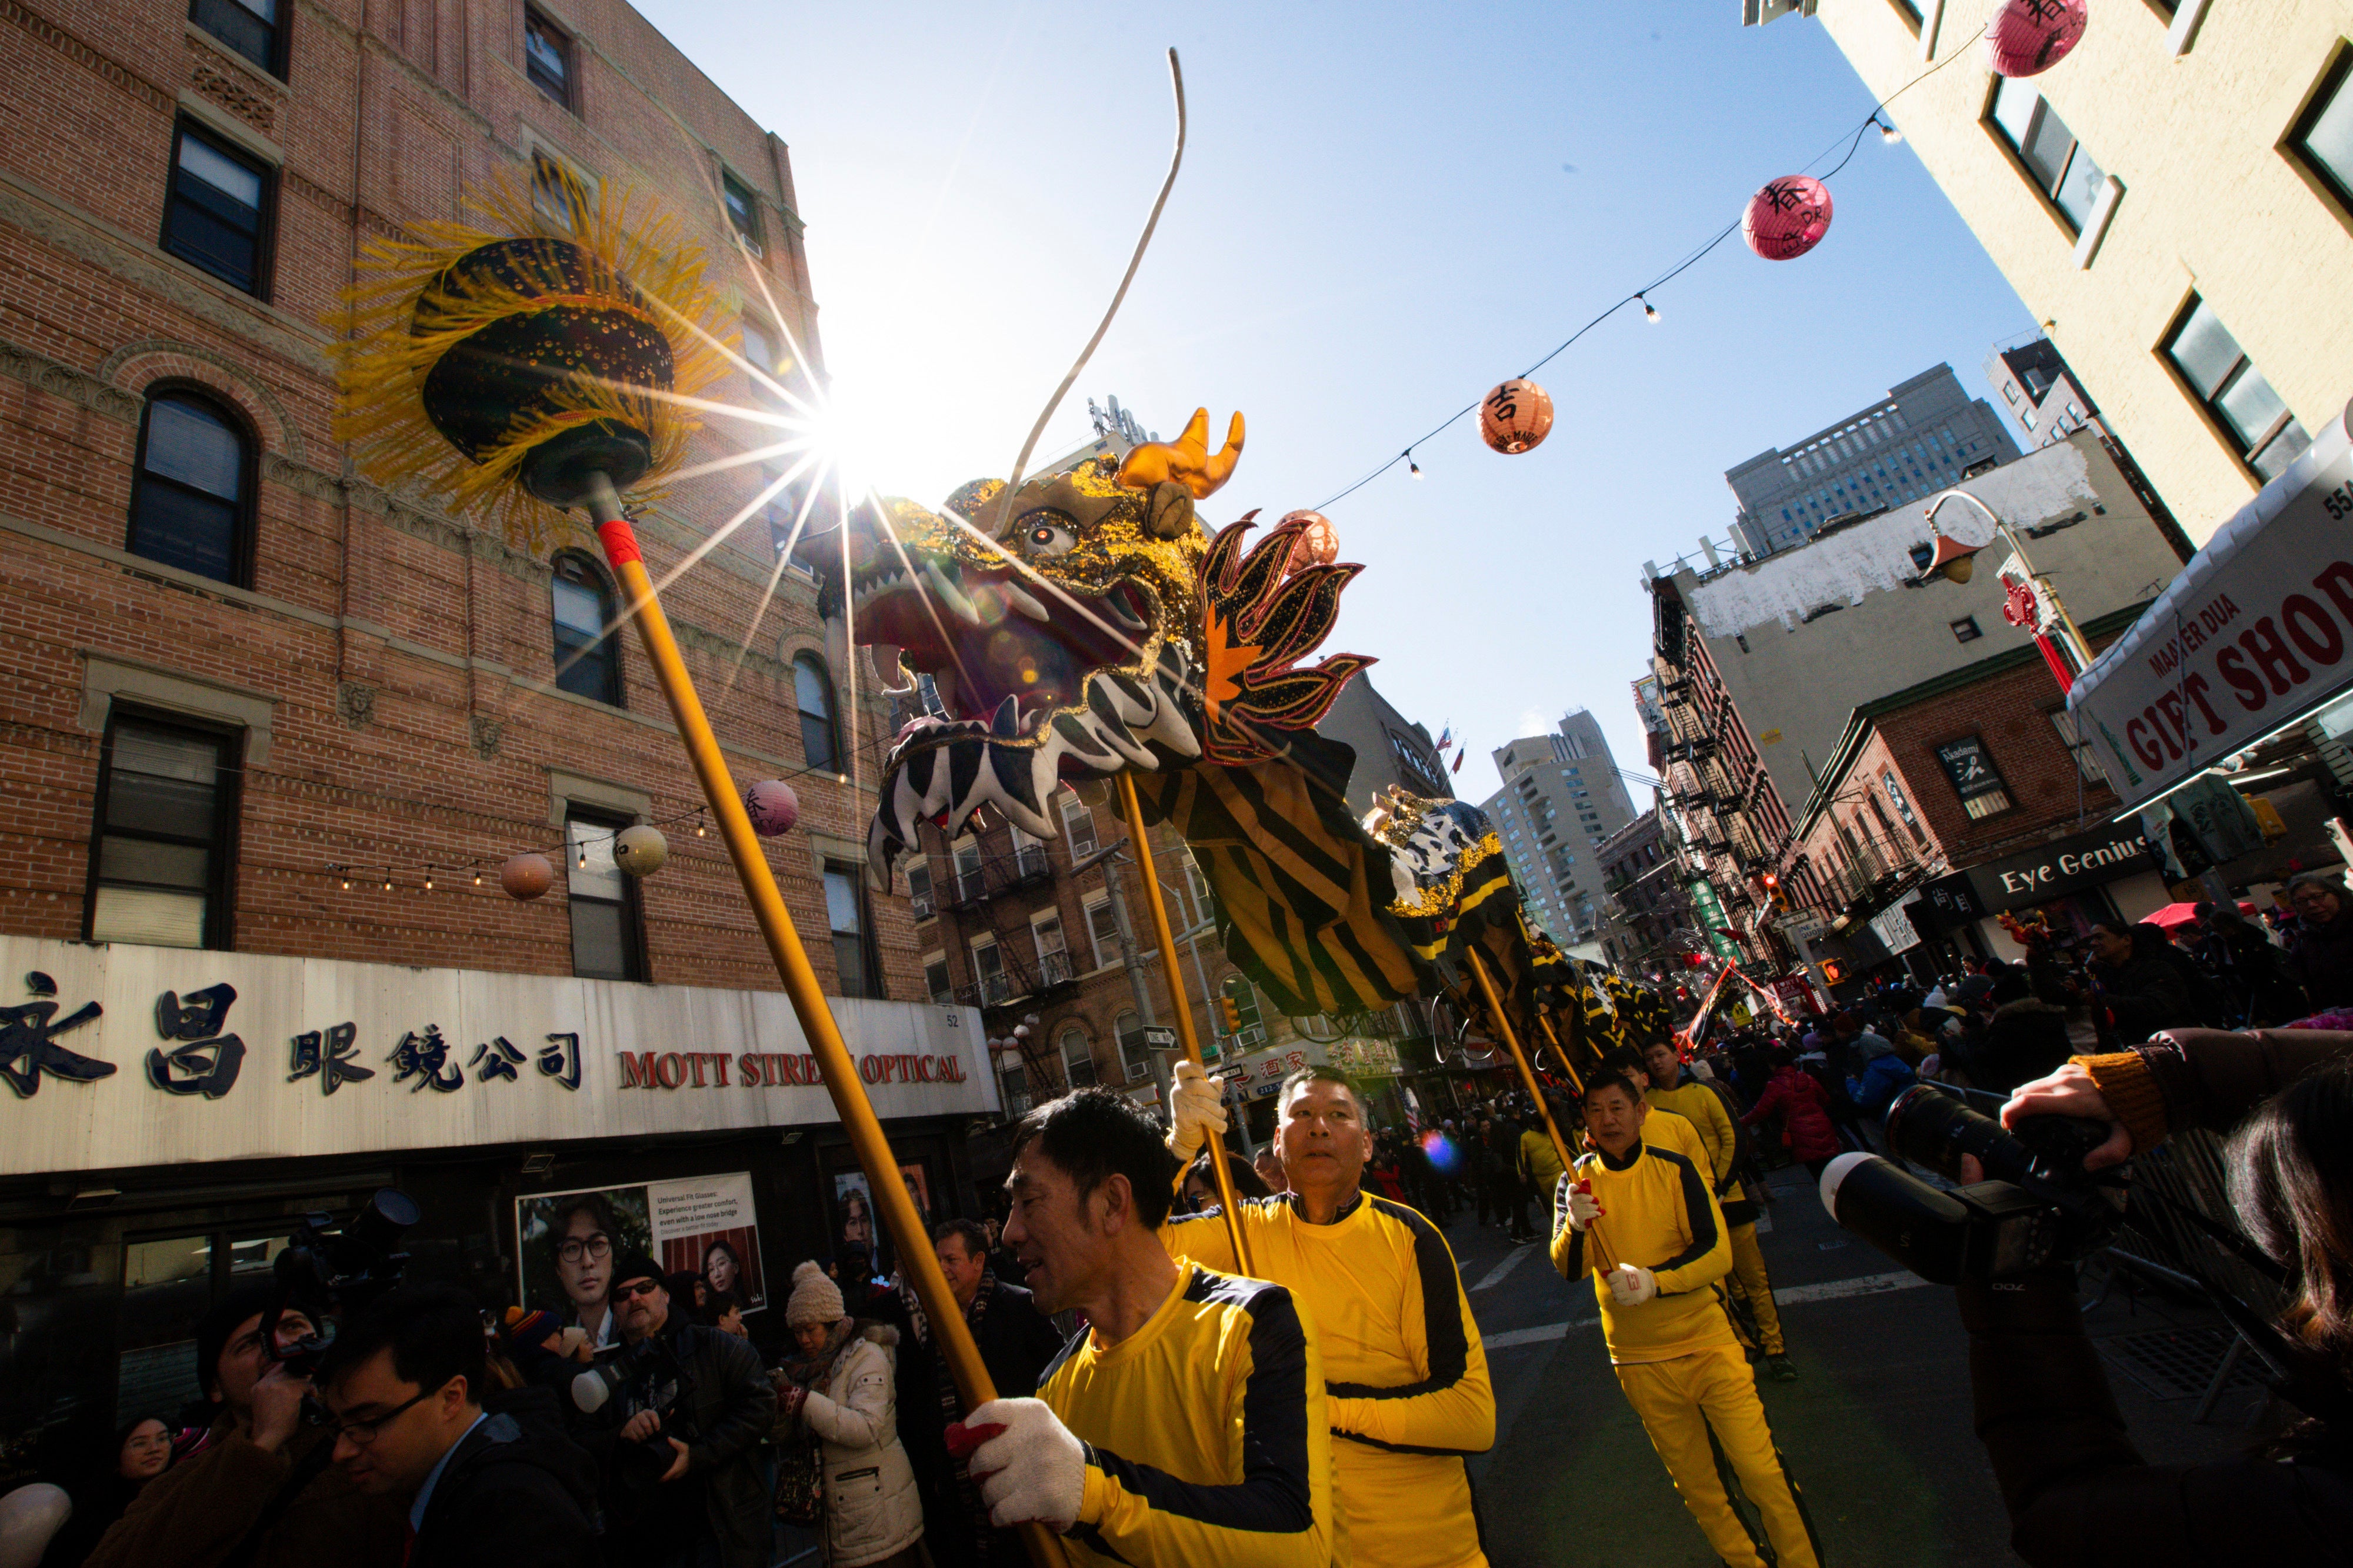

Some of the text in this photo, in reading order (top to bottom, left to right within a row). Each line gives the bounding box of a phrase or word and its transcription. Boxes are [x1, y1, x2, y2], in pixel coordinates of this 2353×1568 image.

[2199, 593, 2241, 635] DUA
[2127, 672, 2228, 771] GIFT
[1999, 865, 2055, 894] Eye
[1792, 913, 1806, 922] WAY
[946, 1015, 959, 1028] 52
[1149, 1033, 1171, 1043] ONE WAY
[619, 1050, 732, 1089] MOTT
[861, 1054, 966, 1083] OPTICAL
[658, 1205, 692, 1215] Experience
[693, 1202, 713, 1212] greater
[694, 1212, 705, 1220] low
[720, 1209, 738, 1217] bridge
